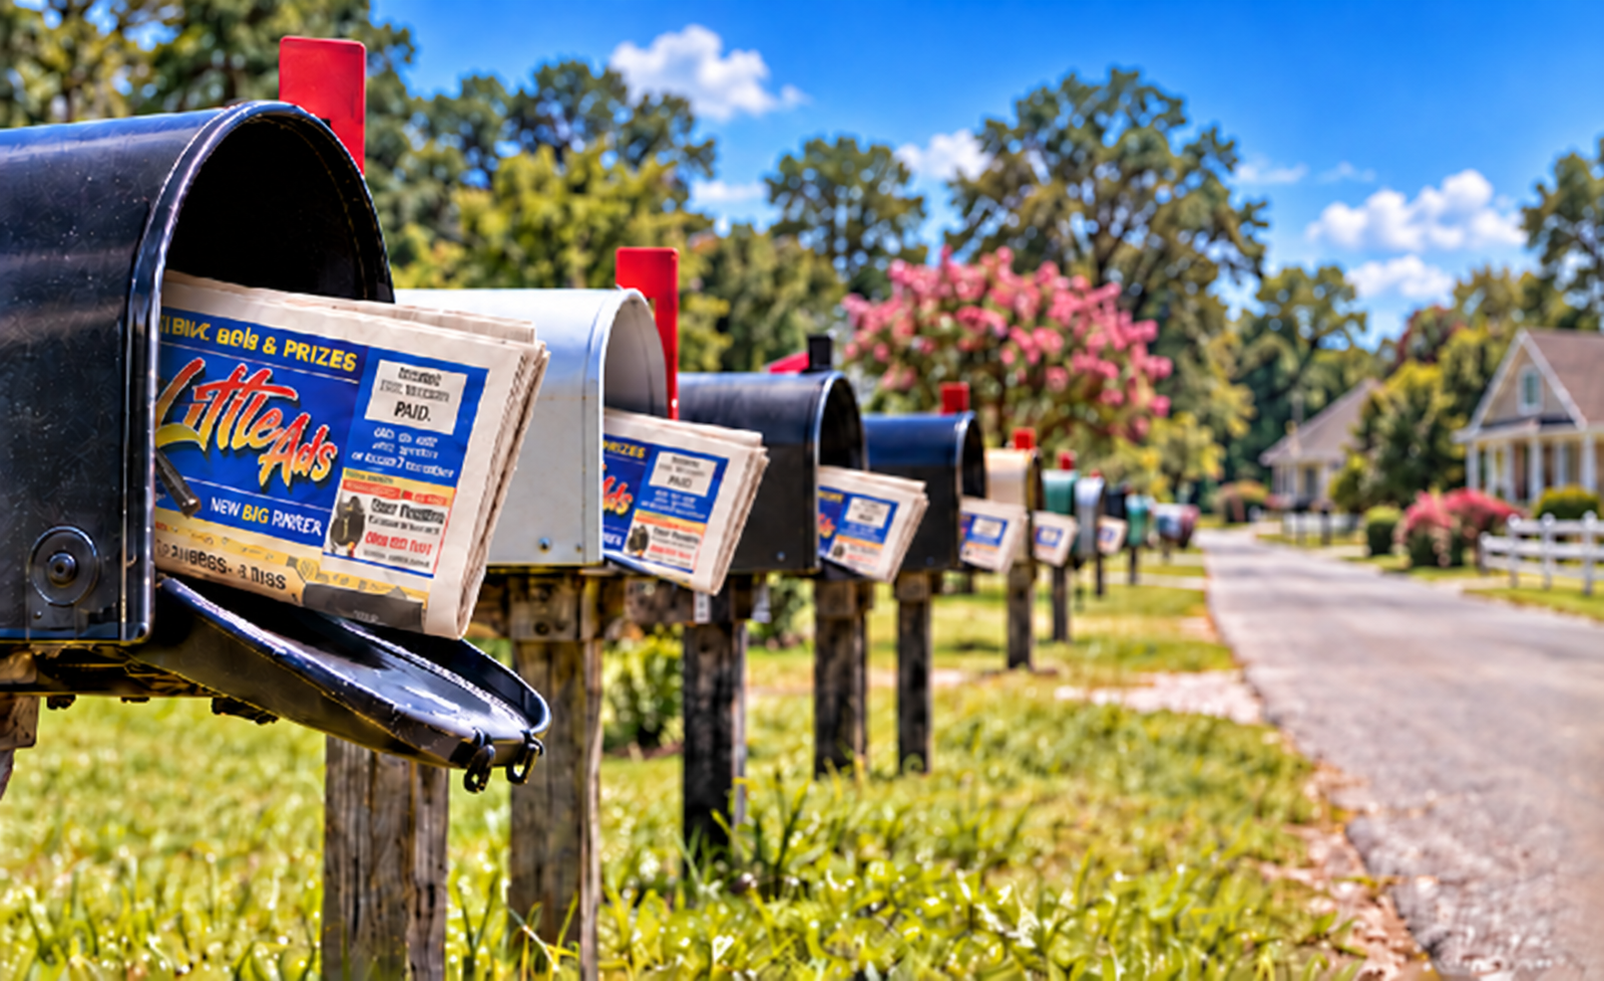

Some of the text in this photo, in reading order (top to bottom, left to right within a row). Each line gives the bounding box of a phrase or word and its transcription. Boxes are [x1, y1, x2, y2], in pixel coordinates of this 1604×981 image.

[283, 339, 358, 372] PRIZES
[155, 356, 299, 452] Little
[257, 412, 338, 487] Ads
[210, 496, 242, 517] NEW
[241, 504, 270, 525] BIG
